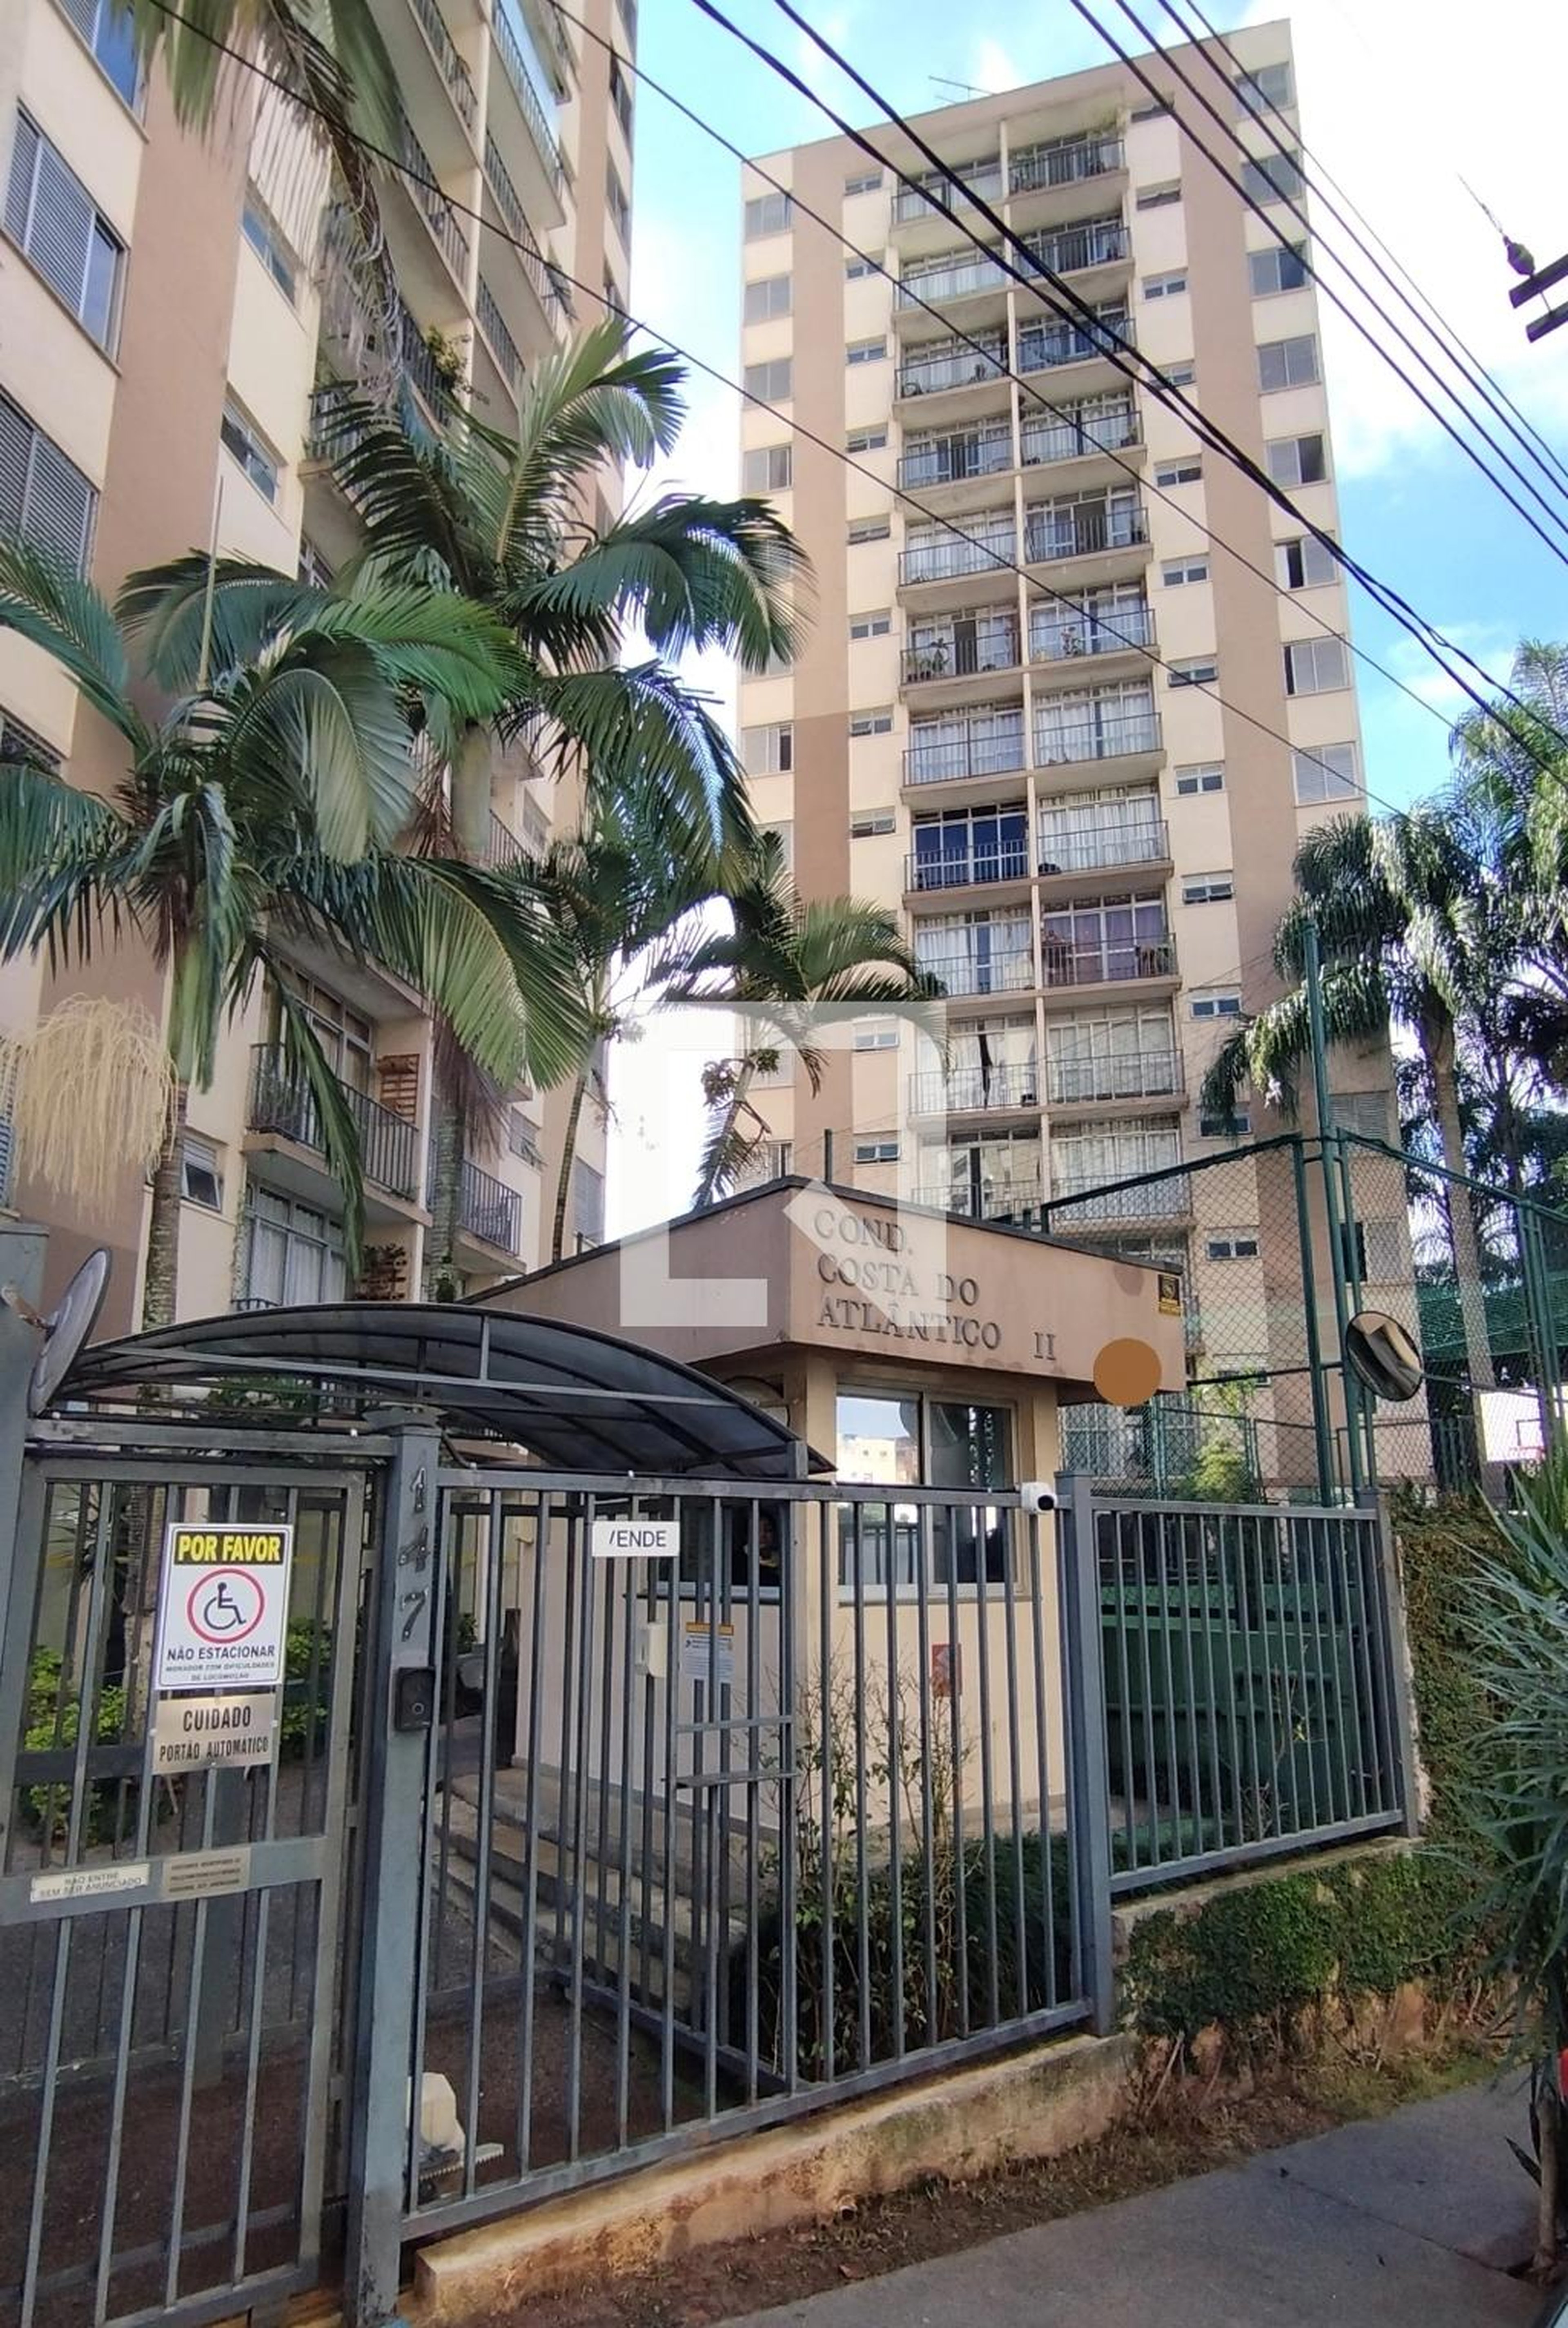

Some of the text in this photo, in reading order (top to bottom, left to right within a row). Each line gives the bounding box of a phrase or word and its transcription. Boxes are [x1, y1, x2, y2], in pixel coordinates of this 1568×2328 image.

[817, 1253, 980, 1306] COSTA DO
[177, 1534, 281, 1562] POR FAVOR
[167, 1645, 275, 1661] NÃO ESTACIONAR
[183, 1706, 251, 1732] CUIDADO
[159, 1739, 200, 1762] PORTÃO
